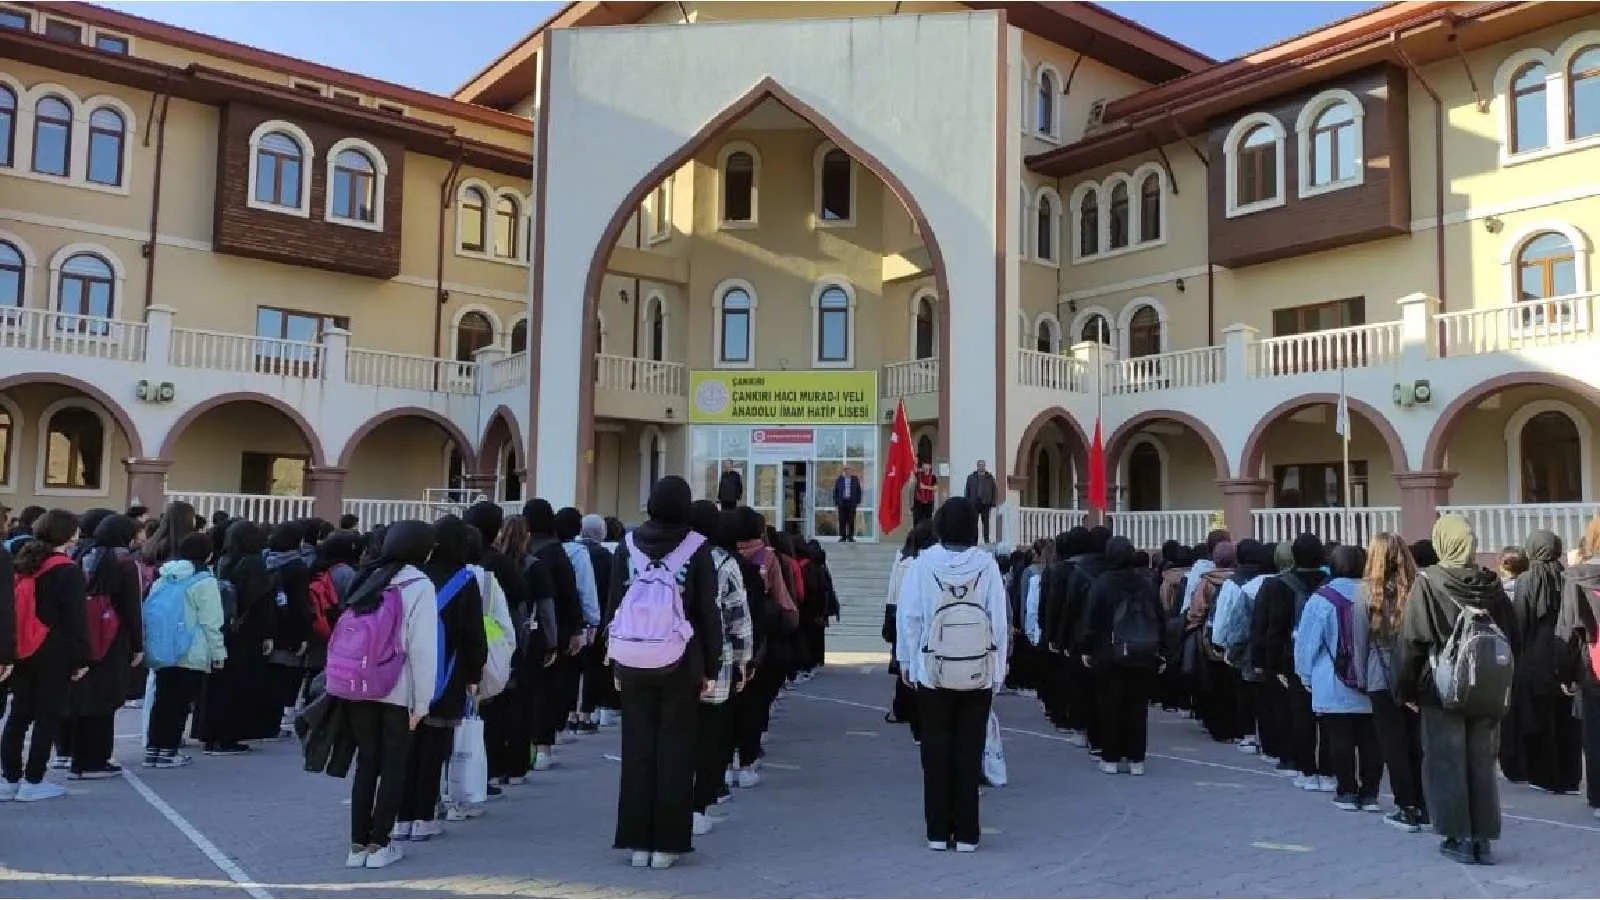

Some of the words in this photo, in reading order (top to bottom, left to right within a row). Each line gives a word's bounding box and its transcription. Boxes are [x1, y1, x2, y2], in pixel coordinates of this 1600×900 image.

[732, 391, 771, 404] ÇANKIRI
[775, 391, 797, 402] HACI
[799, 391, 840, 402] MURAD-I
[732, 406, 776, 417] ANADOLU
[839, 404, 869, 417] LİSESİ
